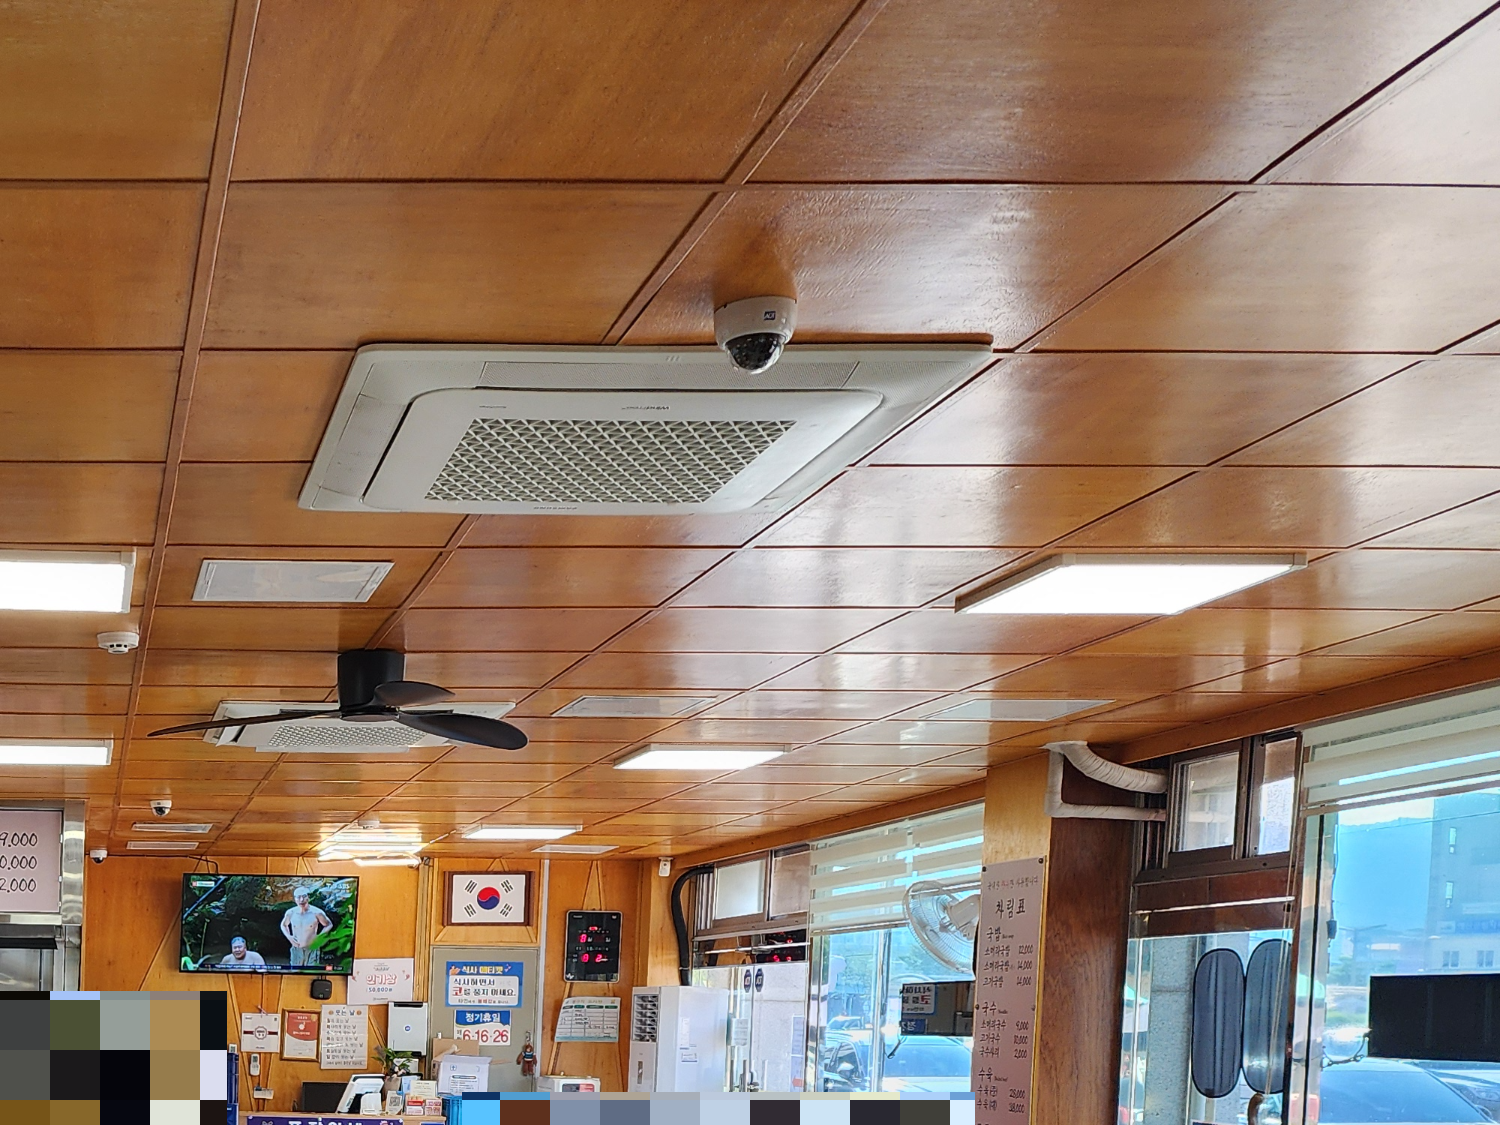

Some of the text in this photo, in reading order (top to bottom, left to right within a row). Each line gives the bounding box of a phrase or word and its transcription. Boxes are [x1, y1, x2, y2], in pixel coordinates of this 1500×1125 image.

[995, 898, 1026, 919] 차림표
[986, 926, 1001, 942] 국밥
[366, 973, 398, 985] 인기상
[981, 1001, 997, 1016] 국수
[465, 1012, 500, 1023] 정기휴일
[978, 1067, 993, 1082] 수육
